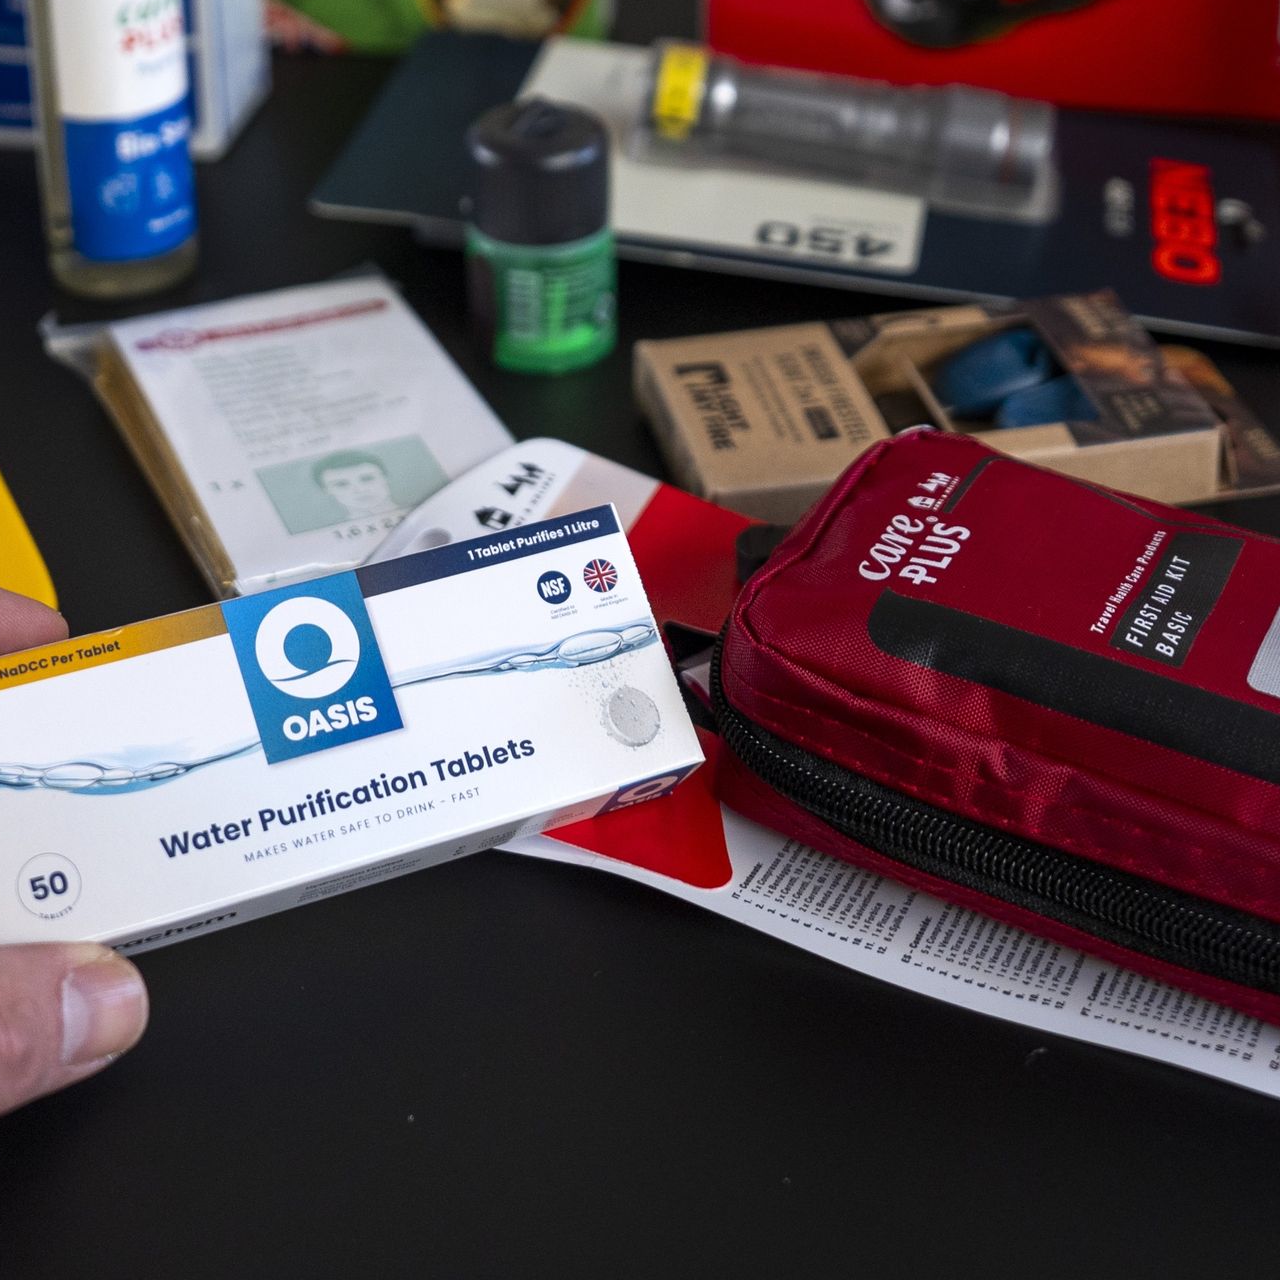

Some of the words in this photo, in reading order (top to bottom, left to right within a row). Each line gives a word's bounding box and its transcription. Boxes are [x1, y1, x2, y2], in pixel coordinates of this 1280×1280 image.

[467, 549, 475, 561] 1
[475, 539, 516, 559] Tablet
[516, 530, 564, 549] Purifies
[564, 525, 571, 536] 1
[572, 519, 600, 534] Litre
[858, 514, 925, 581] care
[898, 522, 971, 585] PLUS
[1090, 602, 1117, 634] Travel
[1109, 582, 1133, 604] Health
[1125, 565, 1145, 585] Care
[1137, 530, 1167, 565] Products
[1125, 603, 1162, 648] FIRST
[1151, 583, 1176, 606] AID
[1165, 555, 1191, 582] KIT
[51, 653, 74, 667] Per
[76, 640, 121, 660] Tablet
[1155, 611, 1193, 658] BASIC
[282, 695, 378, 742] OASIS
[159, 819, 254, 859] Water
[257, 768, 429, 834] Purification
[430, 738, 536, 782] Tablets
[243, 843, 288, 863] MAKES
[292, 829, 336, 849] WATER
[339, 820, 371, 836] SAFE
[375, 812, 392, 825] TO
[396, 800, 436, 820] DRINK
[450, 787, 481, 805] FAST
[29, 870, 69, 901] 50
[738, 861, 762, 888] Contenuto:
[768, 862, 793, 890] Bendaggio
[815, 890, 832, 907] Benda
[828, 892, 845, 911] Nastro
[839, 902, 854, 915] Paio
[863, 902, 884, 923] Forbice
[863, 940, 875, 950] 11.
[875, 904, 897, 928] Pinzetta
[876, 944, 888, 953] 12.
[888, 915, 906, 932] Spille
[900, 954, 912, 962] ES
[908, 916, 932, 948] Contenido:
